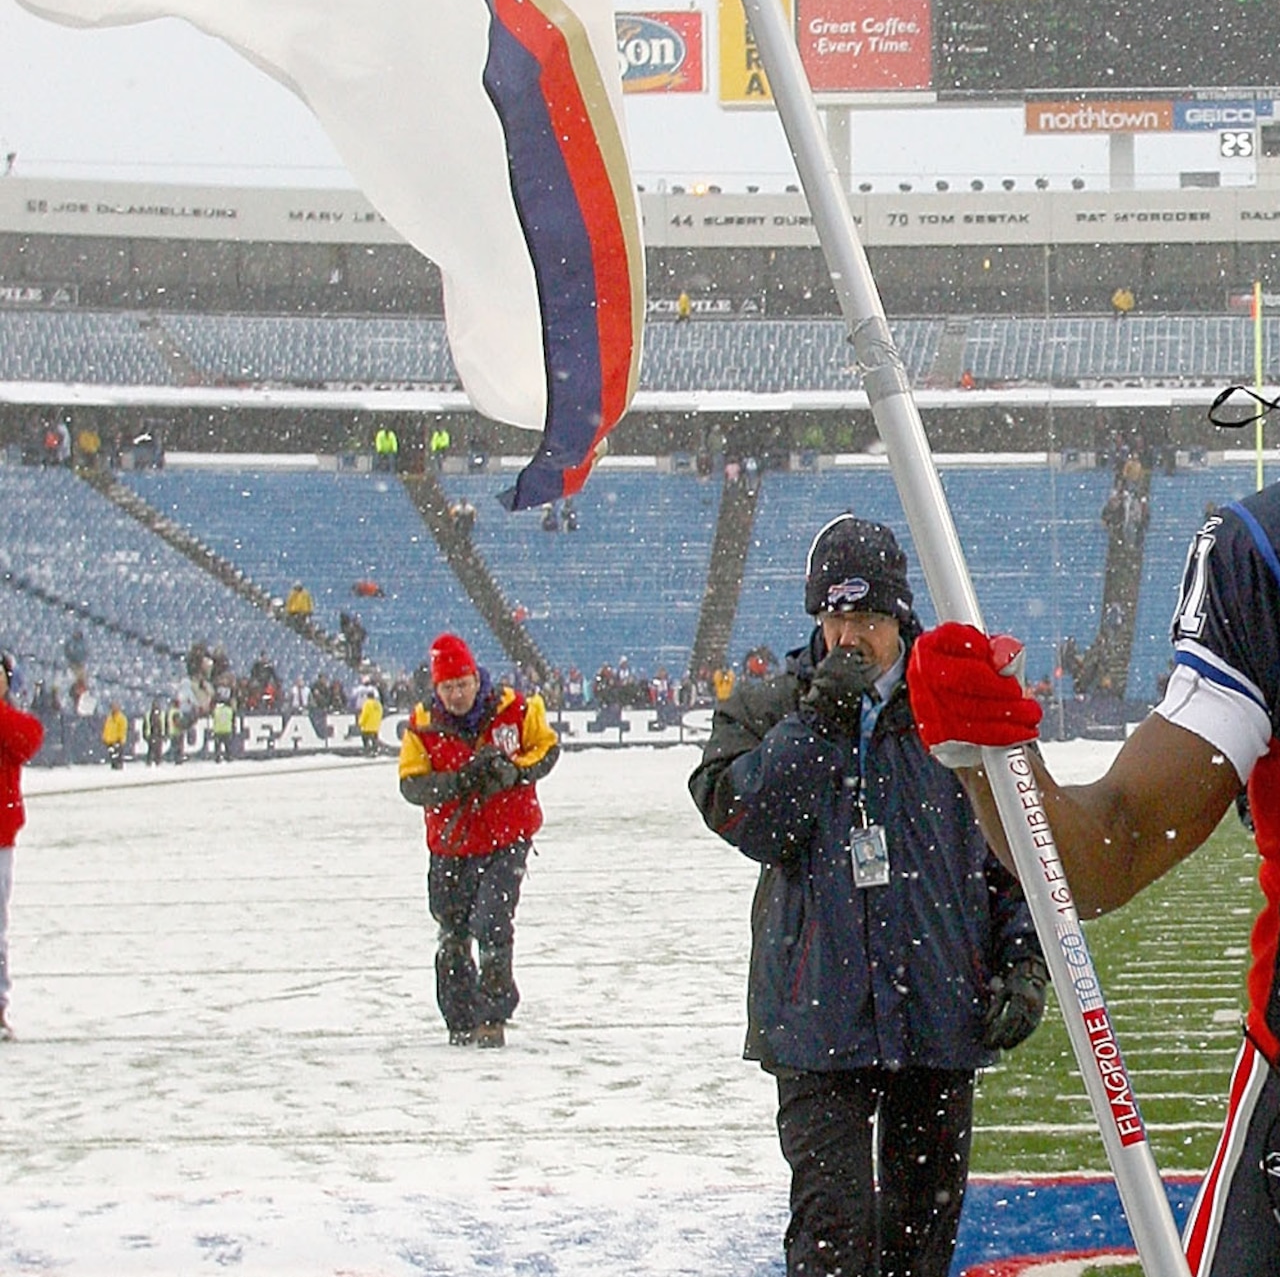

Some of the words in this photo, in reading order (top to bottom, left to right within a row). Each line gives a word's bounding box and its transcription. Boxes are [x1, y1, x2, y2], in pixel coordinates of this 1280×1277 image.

[809, 18, 856, 34] Great
[817, 38, 862, 55] Every
[1039, 108, 1158, 129] northtown
[1185, 108, 1255, 123] GEICO
[670, 214, 695, 227] 44
[1039, 856, 1065, 883] FT
[1051, 886, 1074, 915] 16
[1060, 933, 1088, 968] GO
[1075, 976, 1099, 1010] TO
[1086, 1013, 1142, 1136] FLAGPOLE
